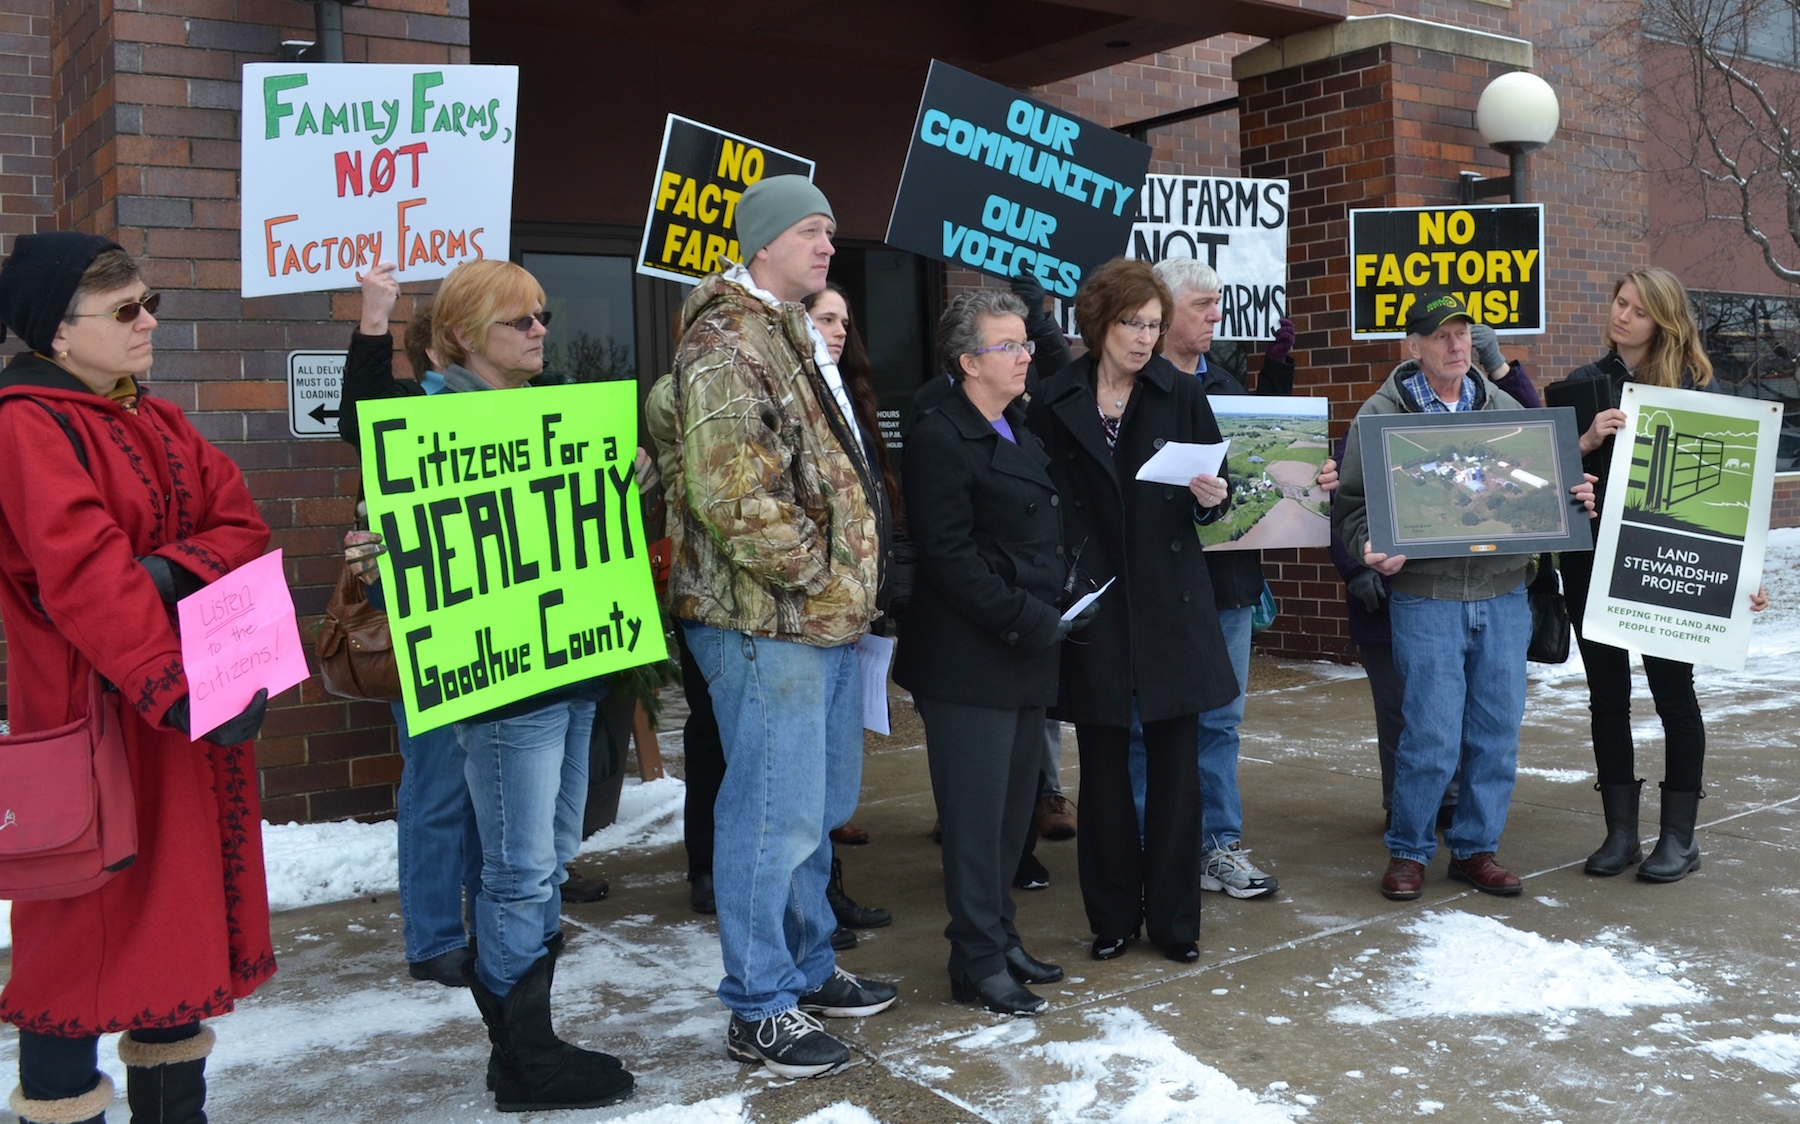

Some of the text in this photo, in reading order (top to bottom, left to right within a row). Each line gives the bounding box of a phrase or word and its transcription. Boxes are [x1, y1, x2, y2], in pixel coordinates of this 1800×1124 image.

[411, 71, 512, 144] FARMS,
[1006, 99, 1080, 156] OUR
[717, 139, 765, 187] NO
[920, 108, 1135, 217] COMMUNITY
[981, 194, 1057, 249] OUR
[1182, 179, 1286, 230] FARMS
[264, 198, 484, 282] FACTORY FARMS
[1418, 210, 1476, 246] NO
[943, 220, 1082, 298] VOICES
[1134, 229, 1229, 273] NOT
[1356, 249, 1539, 288] FACTORY
[1219, 284, 1287, 338] ARMS
[1375, 290, 1520, 327] FAMS!
[296, 378, 321, 386] MUST
[324, 378, 337, 386] GO
[298, 366, 344, 374] ALL DELIV
[300, 390, 340, 399] LOADING
[372, 413, 618, 495] Citizens For a
[380, 460, 635, 619] HEALTHY
[1656, 546, 1700, 565] LAND
[1623, 556, 1729, 585] STEWARDSHIP
[1641, 574, 1706, 596] PROJECT
[200, 585, 255, 627] Listen
[1607, 605, 1727, 634] KEEPING THE LAND AND
[208, 623, 259, 657] to the
[406, 588, 642, 712] Goodhue County
[1618, 620, 1711, 644] PEOPLE TOGETHER
